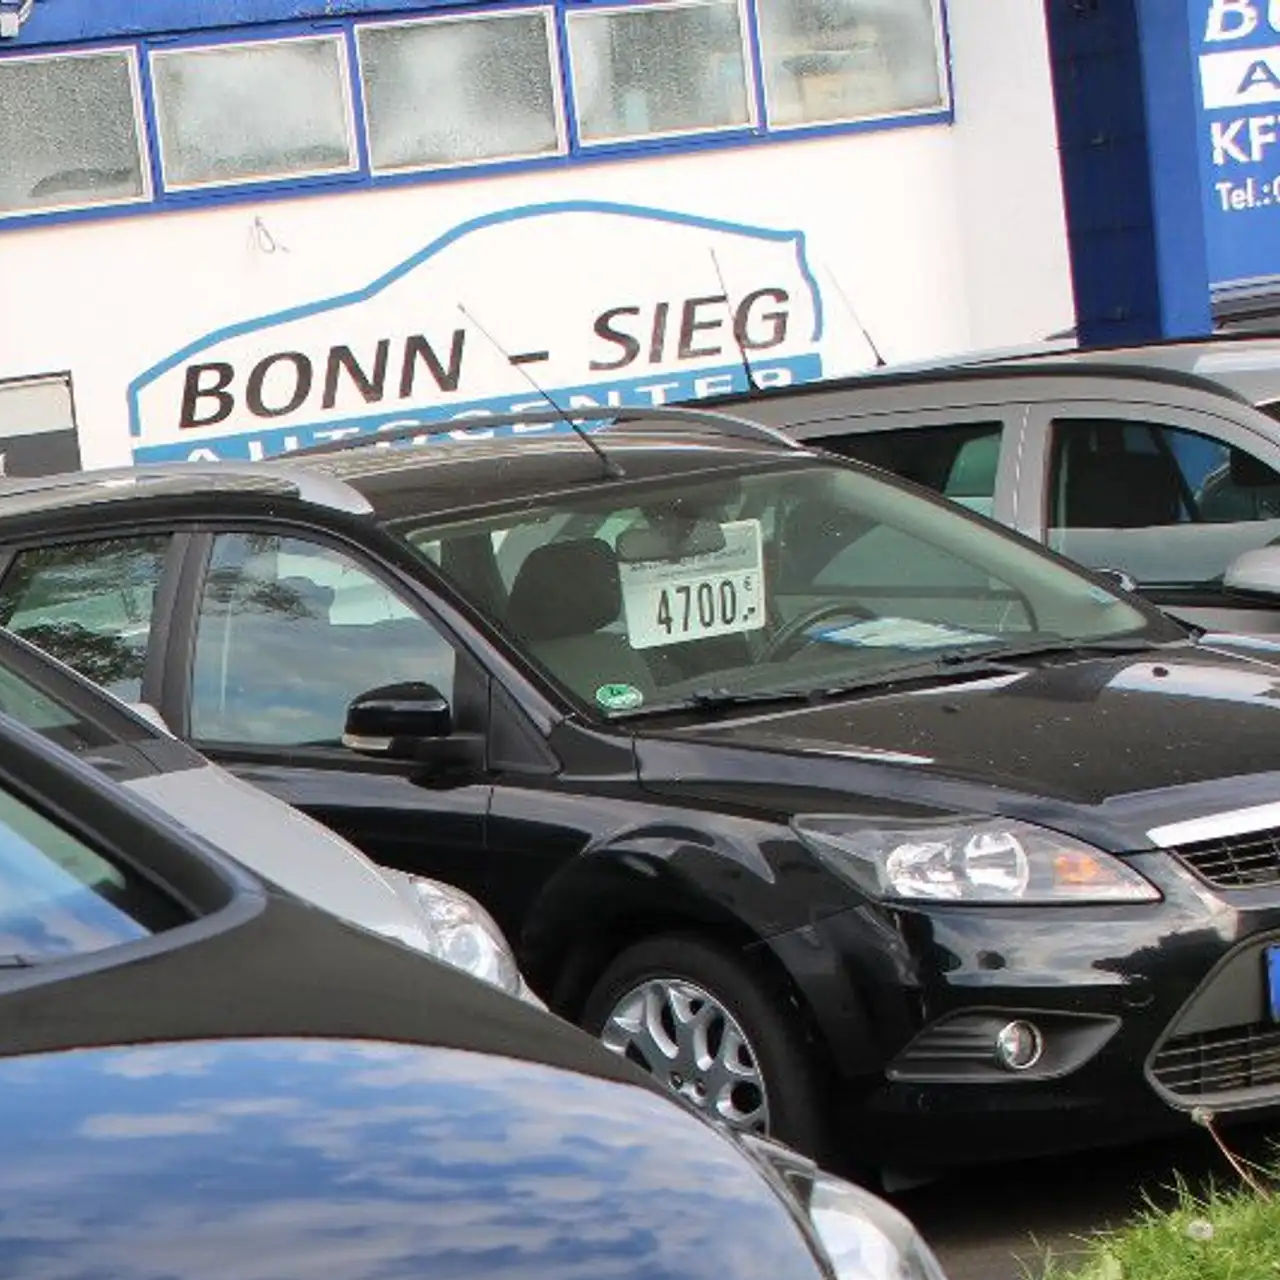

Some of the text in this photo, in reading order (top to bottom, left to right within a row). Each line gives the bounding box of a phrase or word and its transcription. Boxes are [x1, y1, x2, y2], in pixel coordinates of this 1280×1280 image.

[1210, 115, 1280, 165] KF
[179, 329, 465, 428] BONN
[590, 288, 788, 370] SIEG
